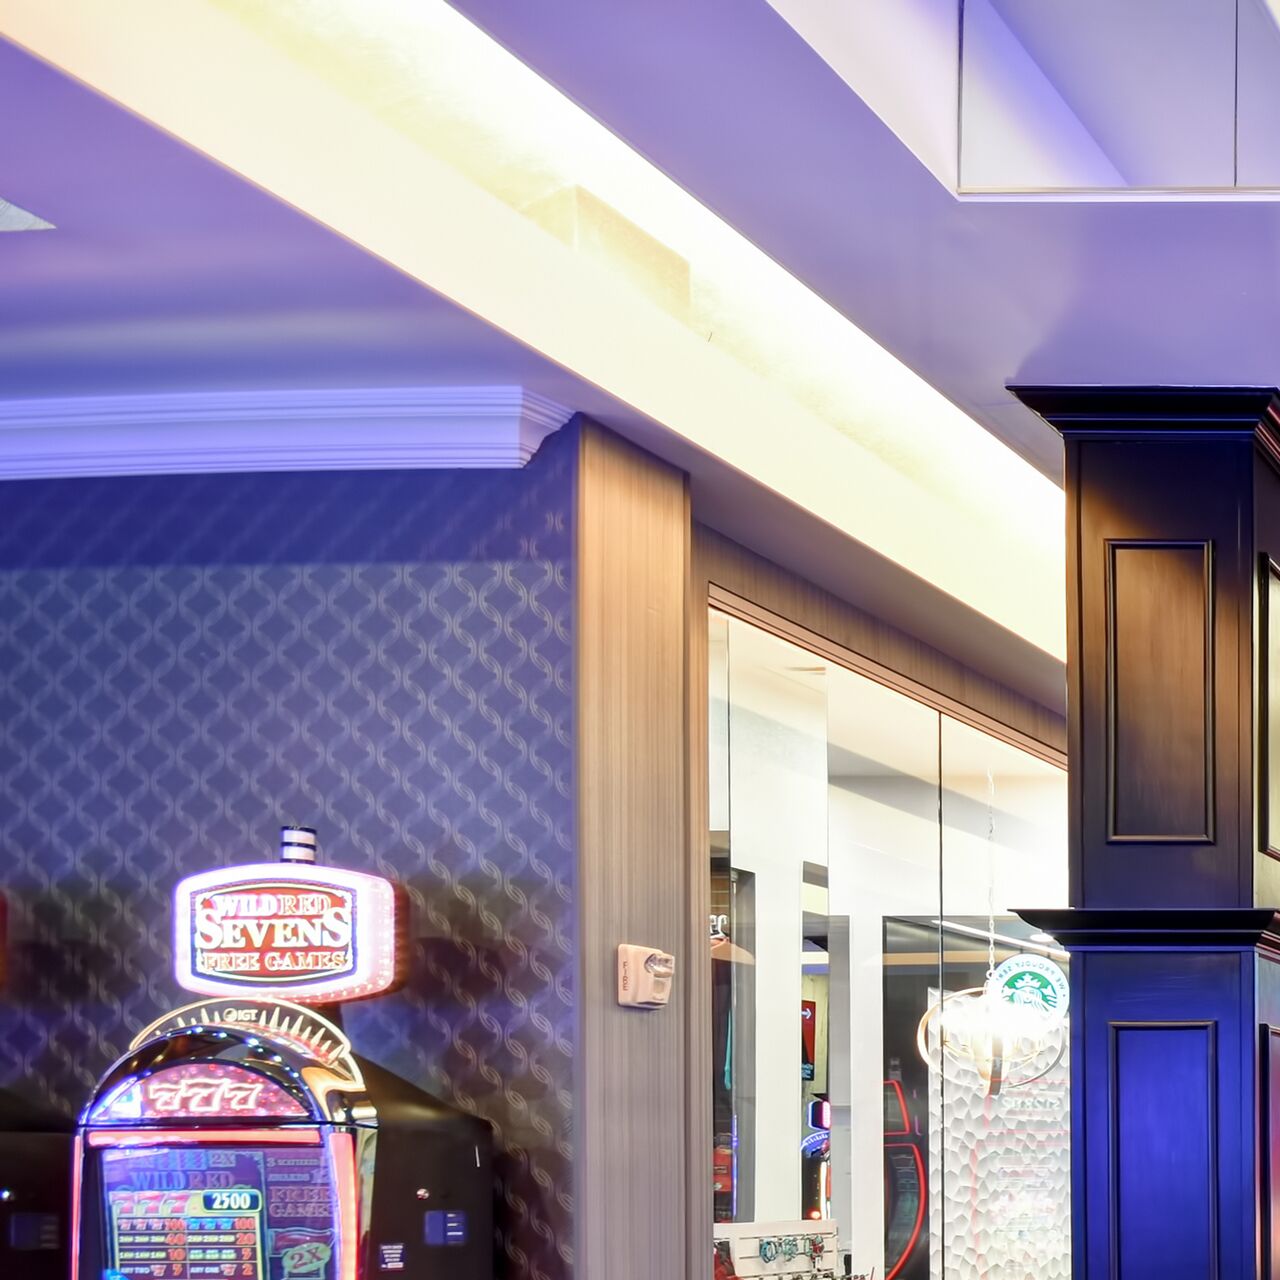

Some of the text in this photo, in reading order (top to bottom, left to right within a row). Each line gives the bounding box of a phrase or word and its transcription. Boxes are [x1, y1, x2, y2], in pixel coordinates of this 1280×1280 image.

[213, 893, 332, 917] WILD RED
[195, 906, 351, 949] SEVENS
[203, 951, 346, 972] FREE GAMES
[237, 1008, 259, 1021] IGT
[129, 1171, 186, 1191] WILD
[212, 1192, 251, 1209] 2500
